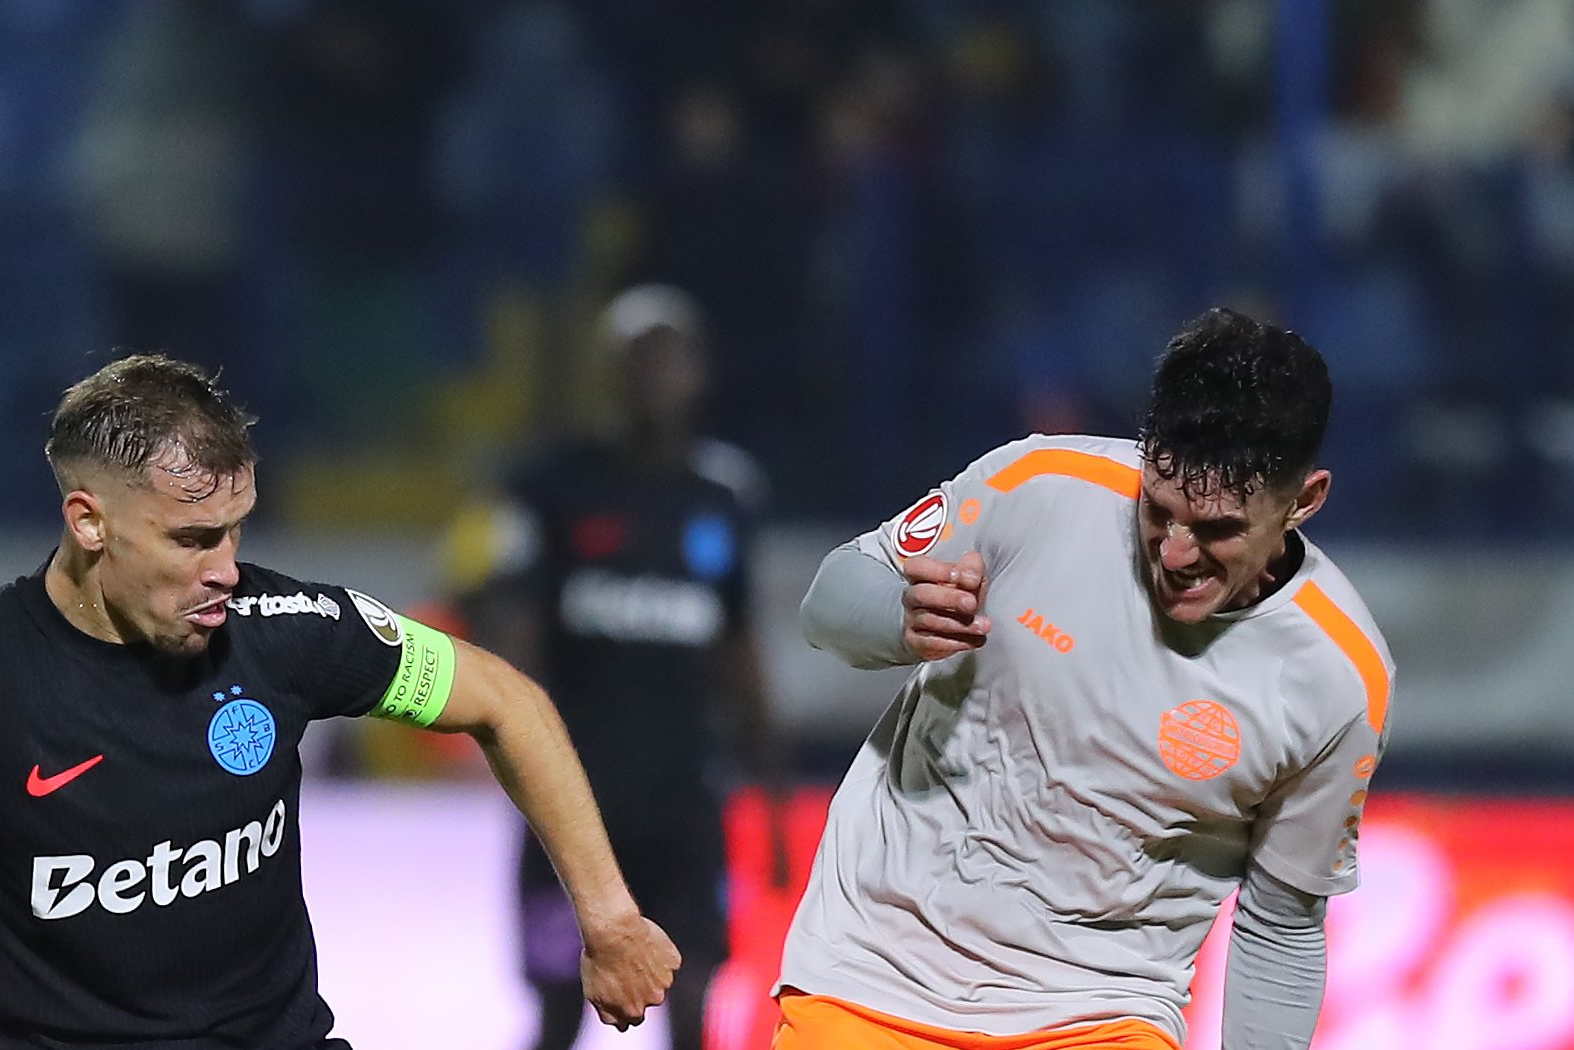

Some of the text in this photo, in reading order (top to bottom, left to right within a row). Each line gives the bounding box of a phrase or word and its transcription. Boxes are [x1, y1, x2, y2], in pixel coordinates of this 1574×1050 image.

[1017, 608, 1075, 653] JAKO
[394, 685, 407, 701] TO
[402, 633, 415, 682] RACISM
[413, 647, 435, 706] RESPECT
[30, 800, 286, 920] Betano
